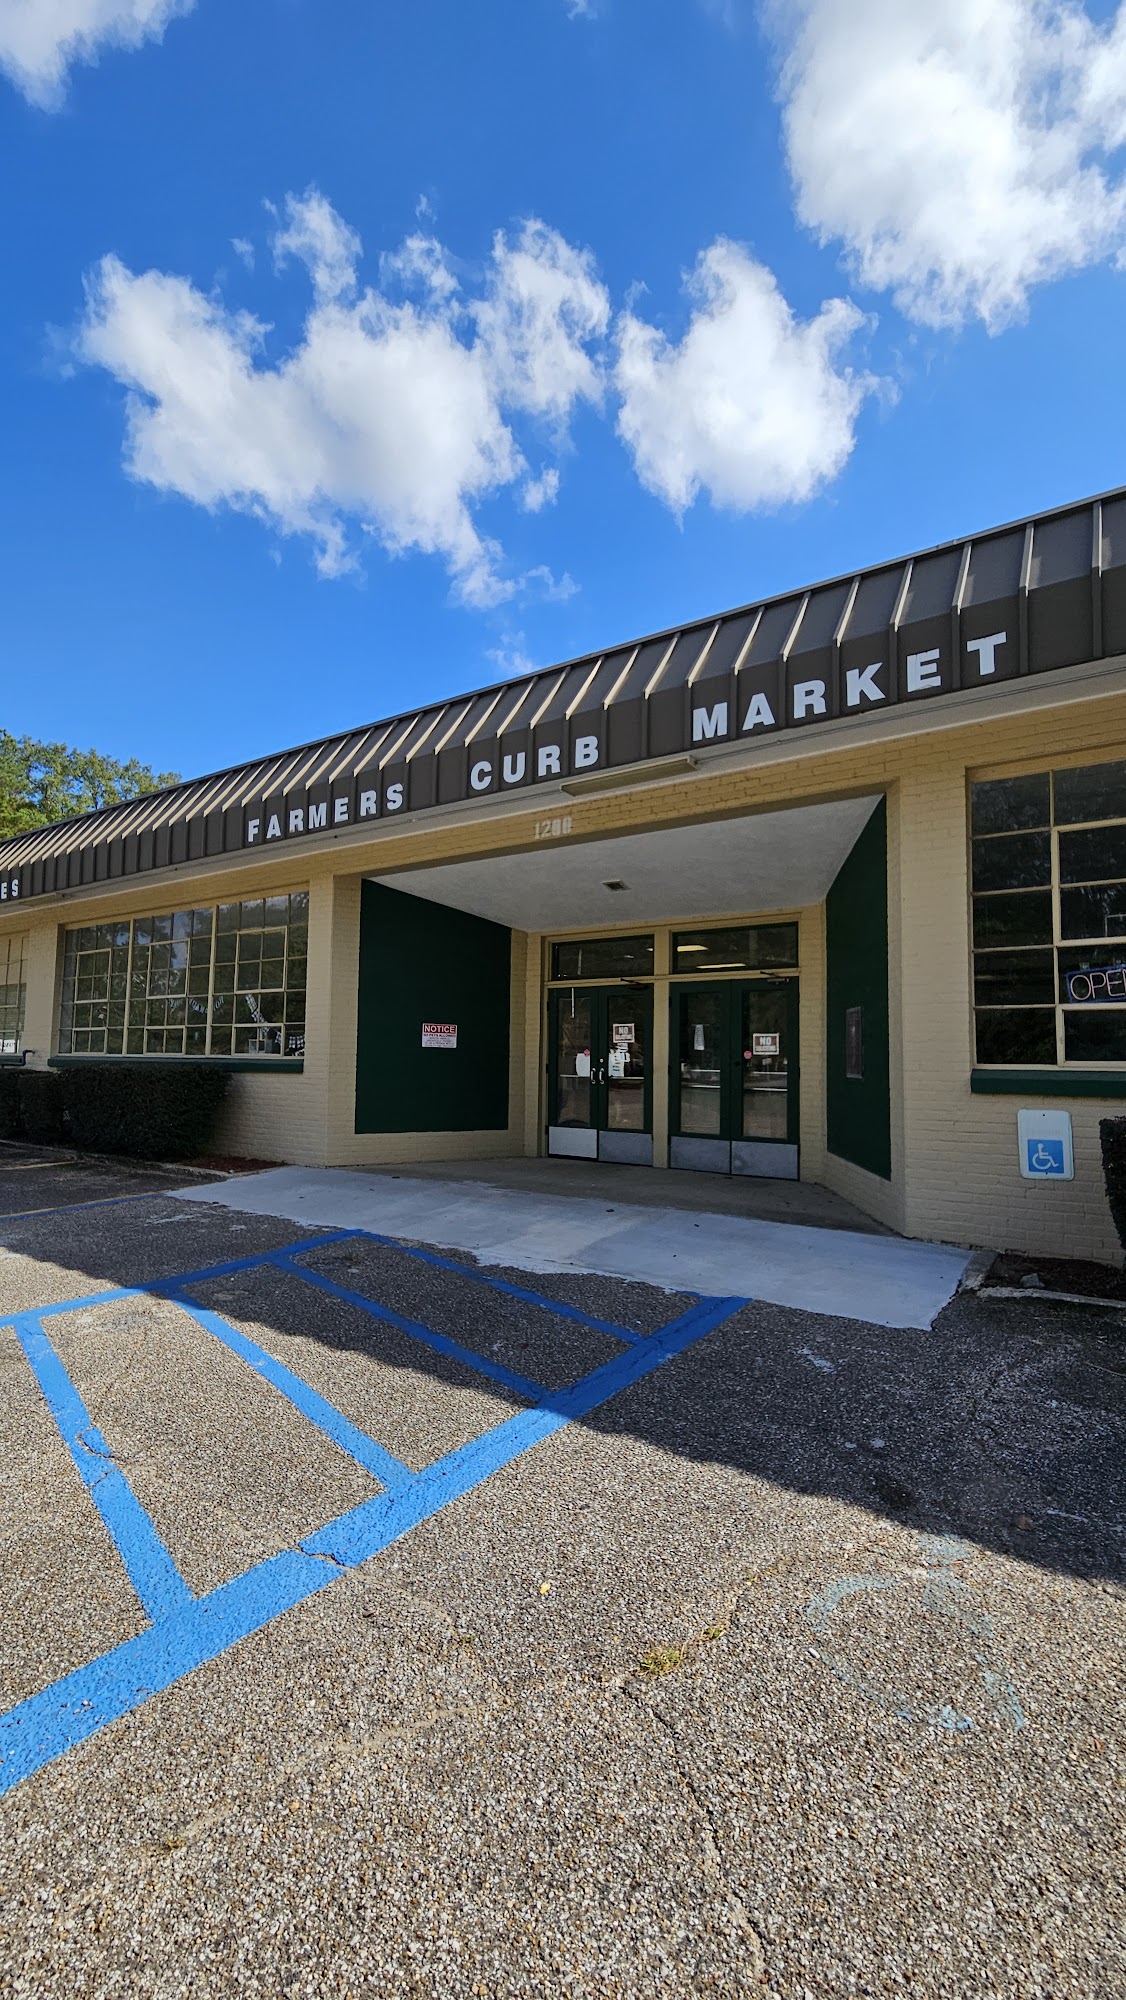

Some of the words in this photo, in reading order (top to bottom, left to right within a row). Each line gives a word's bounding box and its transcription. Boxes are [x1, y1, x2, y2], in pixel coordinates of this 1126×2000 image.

[248, 783, 404, 842] FARMERS
[470, 735, 599, 791] CURB
[692, 631, 1007, 742] MARKET
[1070, 968, 1126, 1000] OPE
[424, 1025, 456, 1033] NOTICE
[759, 1036, 772, 1046] NO
